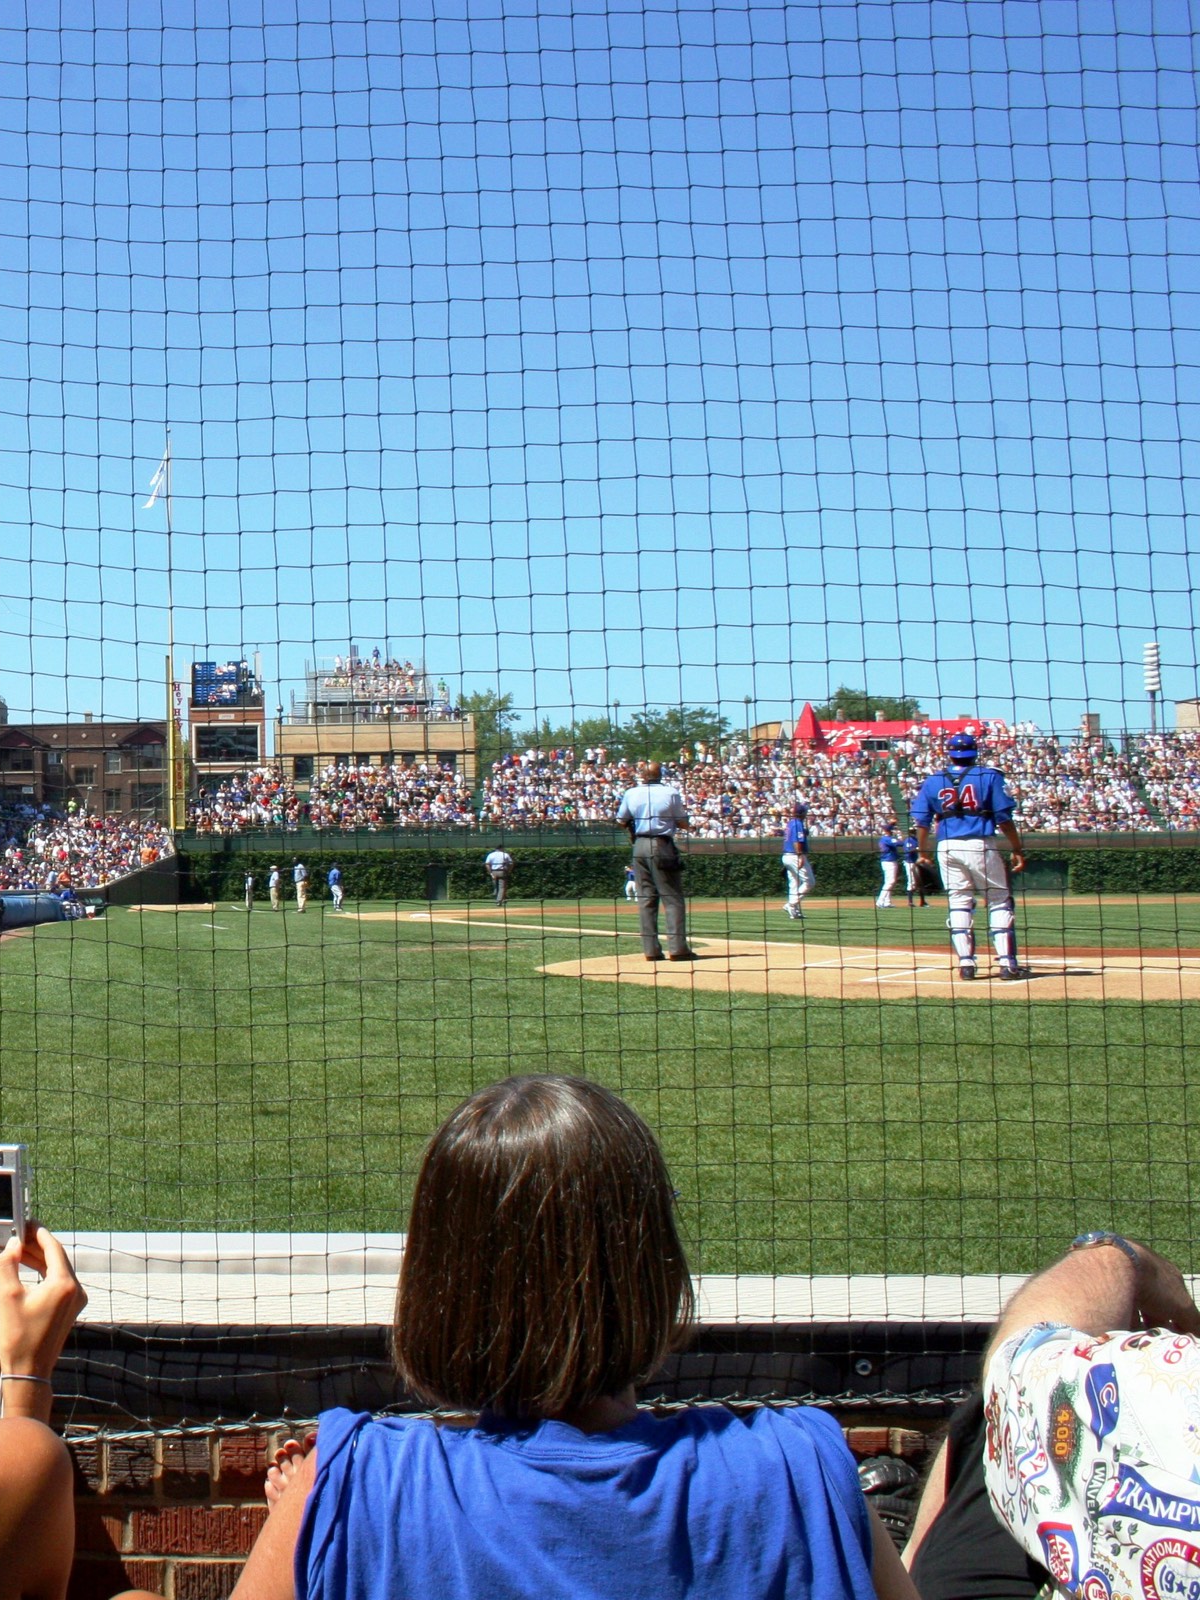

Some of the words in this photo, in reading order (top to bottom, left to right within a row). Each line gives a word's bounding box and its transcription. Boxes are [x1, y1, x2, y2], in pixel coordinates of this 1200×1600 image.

[937, 783, 979, 813] 24
[1099, 1382, 1117, 1408] C
[1055, 1410, 1071, 1456] 400
[1142, 1540, 1188, 1578] NATIONAL
